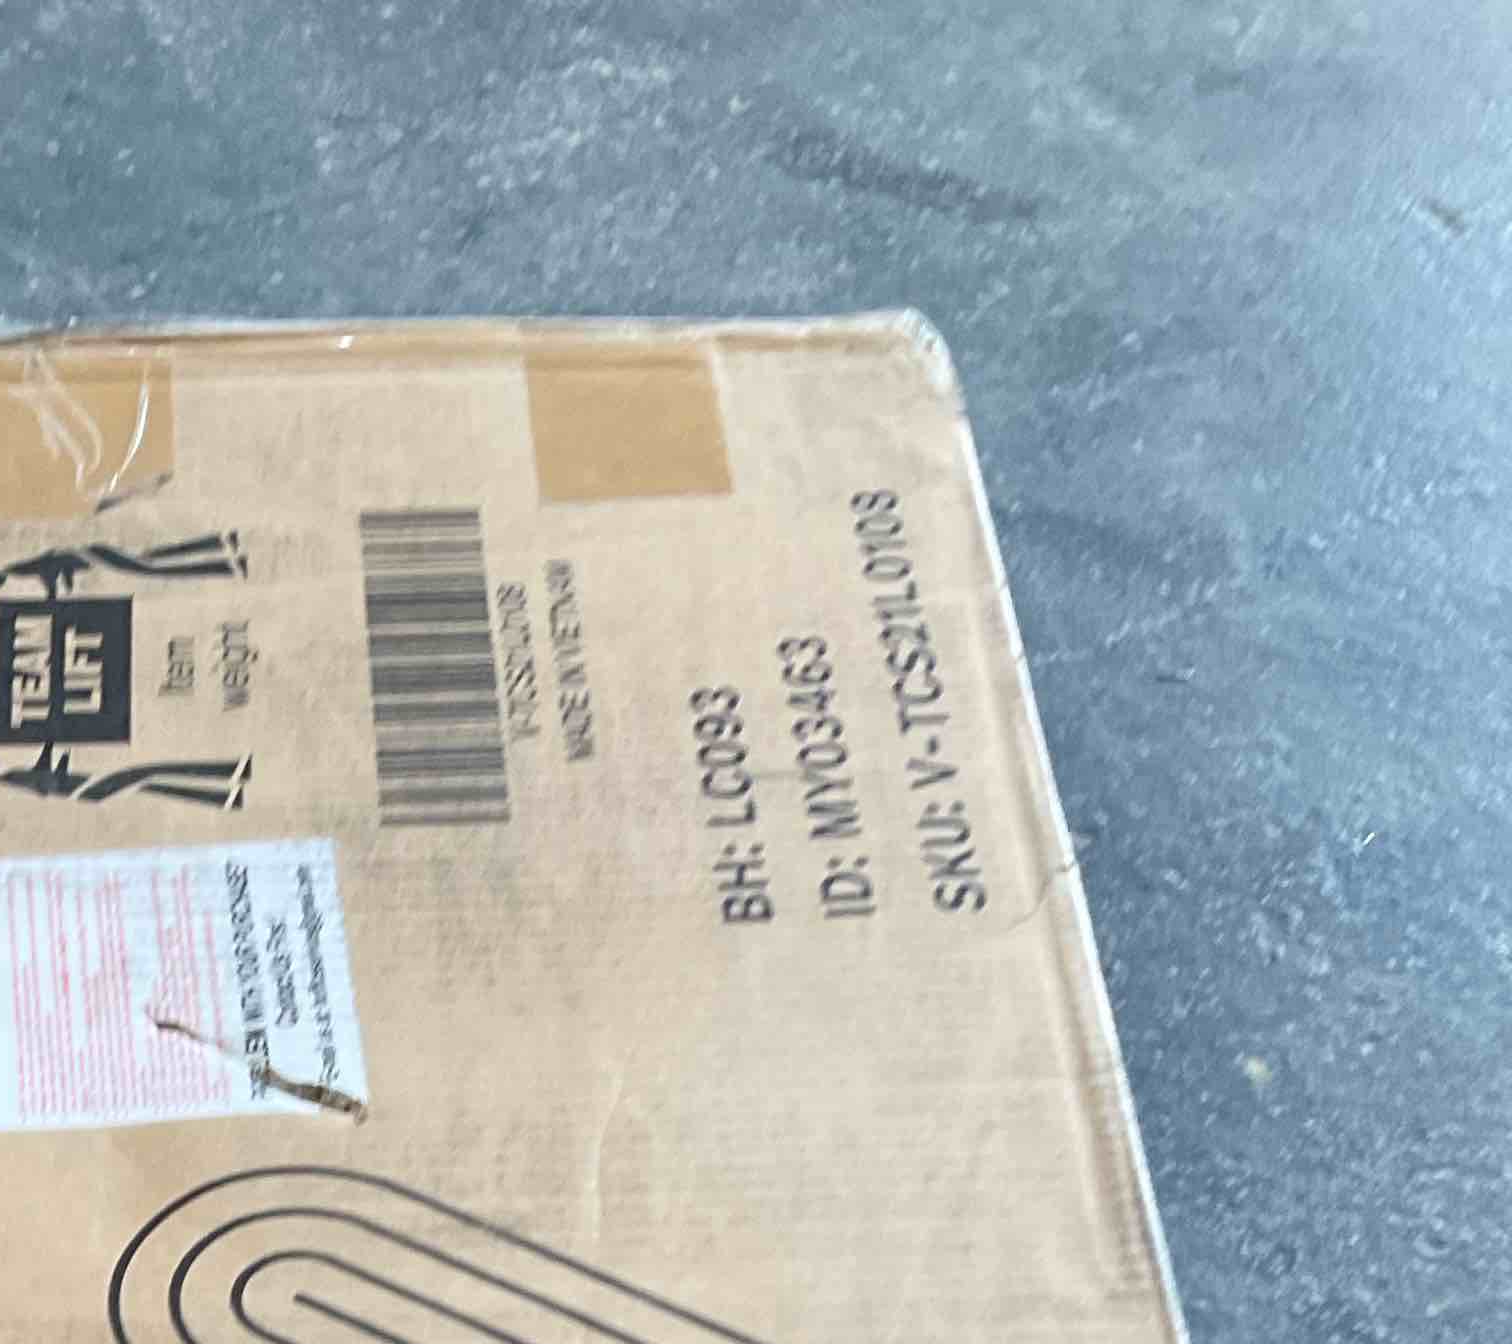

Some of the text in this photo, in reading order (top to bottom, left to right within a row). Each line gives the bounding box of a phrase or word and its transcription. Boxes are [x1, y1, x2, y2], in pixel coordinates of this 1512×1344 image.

[10, 612, 53, 729] TEAM
[63, 624, 104, 714] LIFT
[159, 638, 196, 696] Item
[213, 621, 260, 712] weight
[848, 488, 988, 913] SKU: V-TCS21L0108
[689, 684, 774, 925] BH: LC093
[776, 634, 876, 918] ID: MY03463
